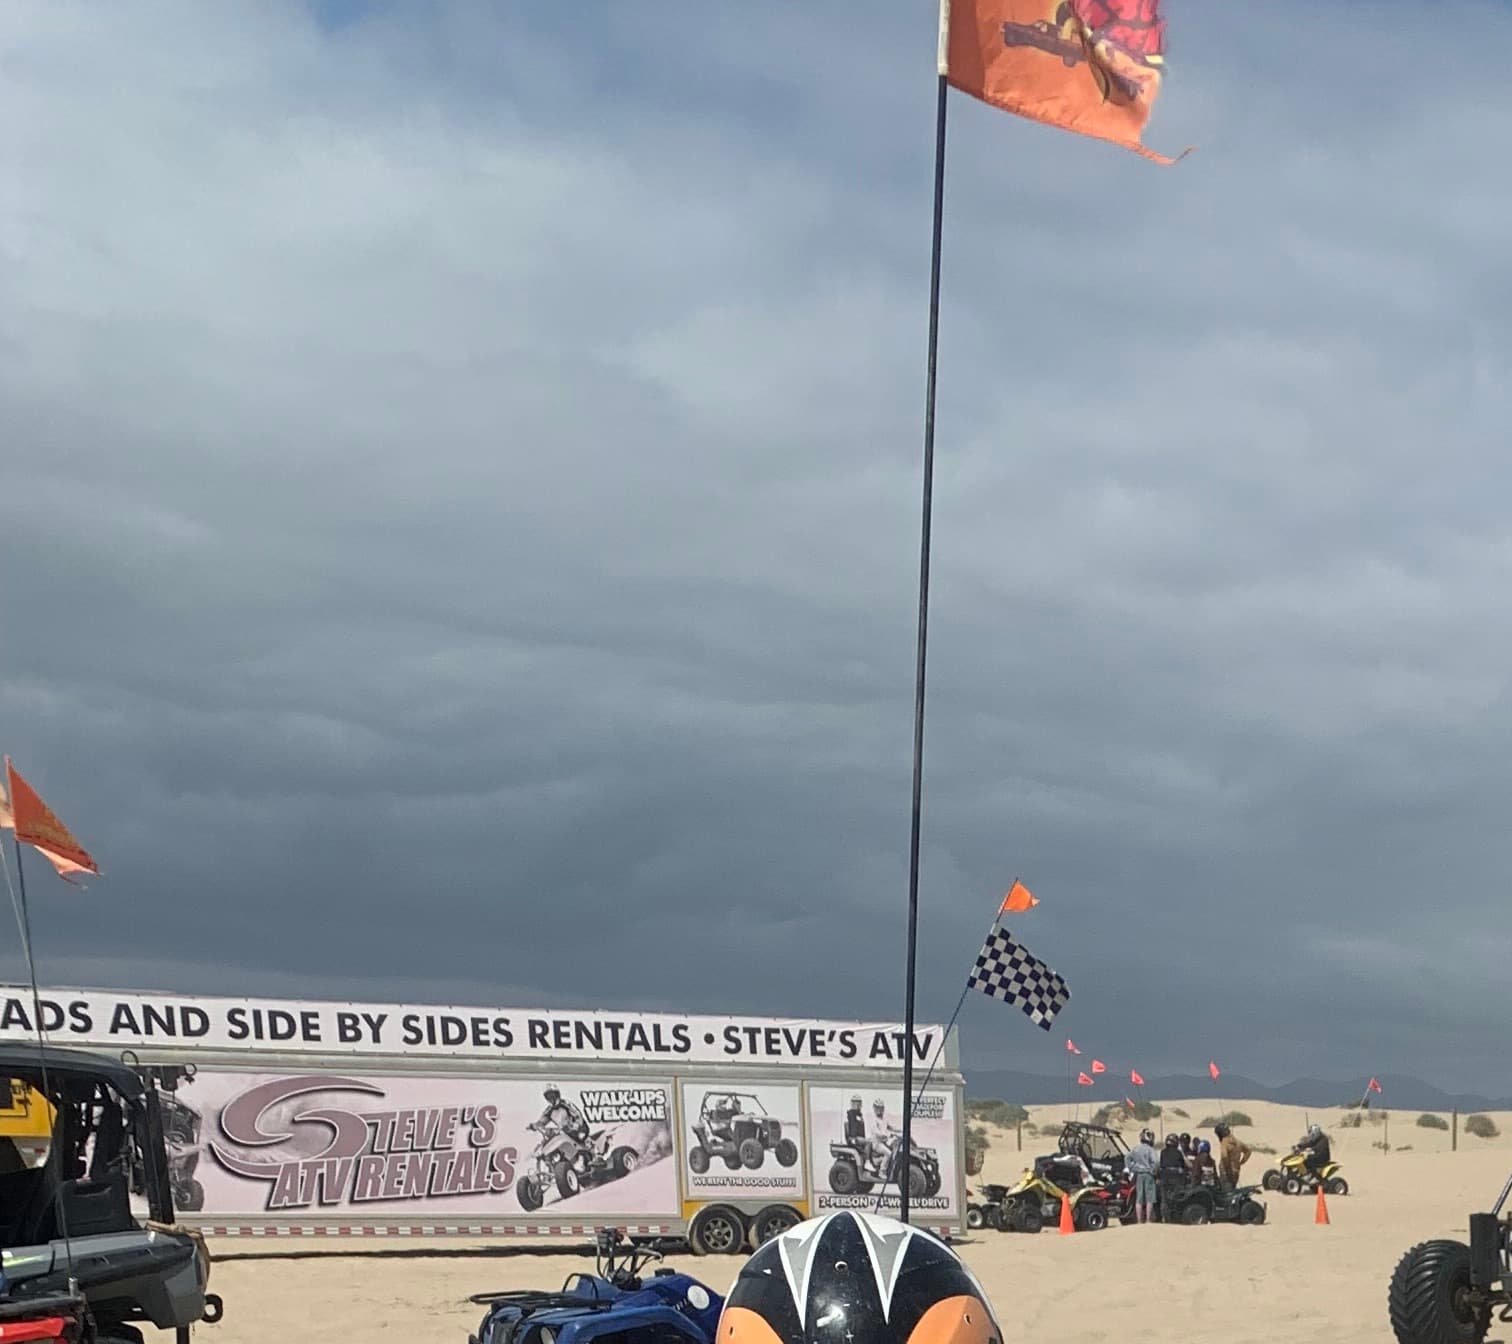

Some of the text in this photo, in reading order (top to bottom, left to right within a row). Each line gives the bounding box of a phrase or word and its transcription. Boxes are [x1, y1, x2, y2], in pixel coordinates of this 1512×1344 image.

[1, 998, 933, 1061] ADS AND SIDE BY SIDES RENTALS STEVE'S ATV
[580, 1089, 666, 1106] WALK-UPS
[585, 1106, 666, 1122] WELCOME
[267, 1146, 518, 1210] ATV RENTALS
[744, 1177, 770, 1187] GOOD
[819, 1196, 869, 1208] 2-PERSON
[920, 1197, 950, 1209] DRIVE
